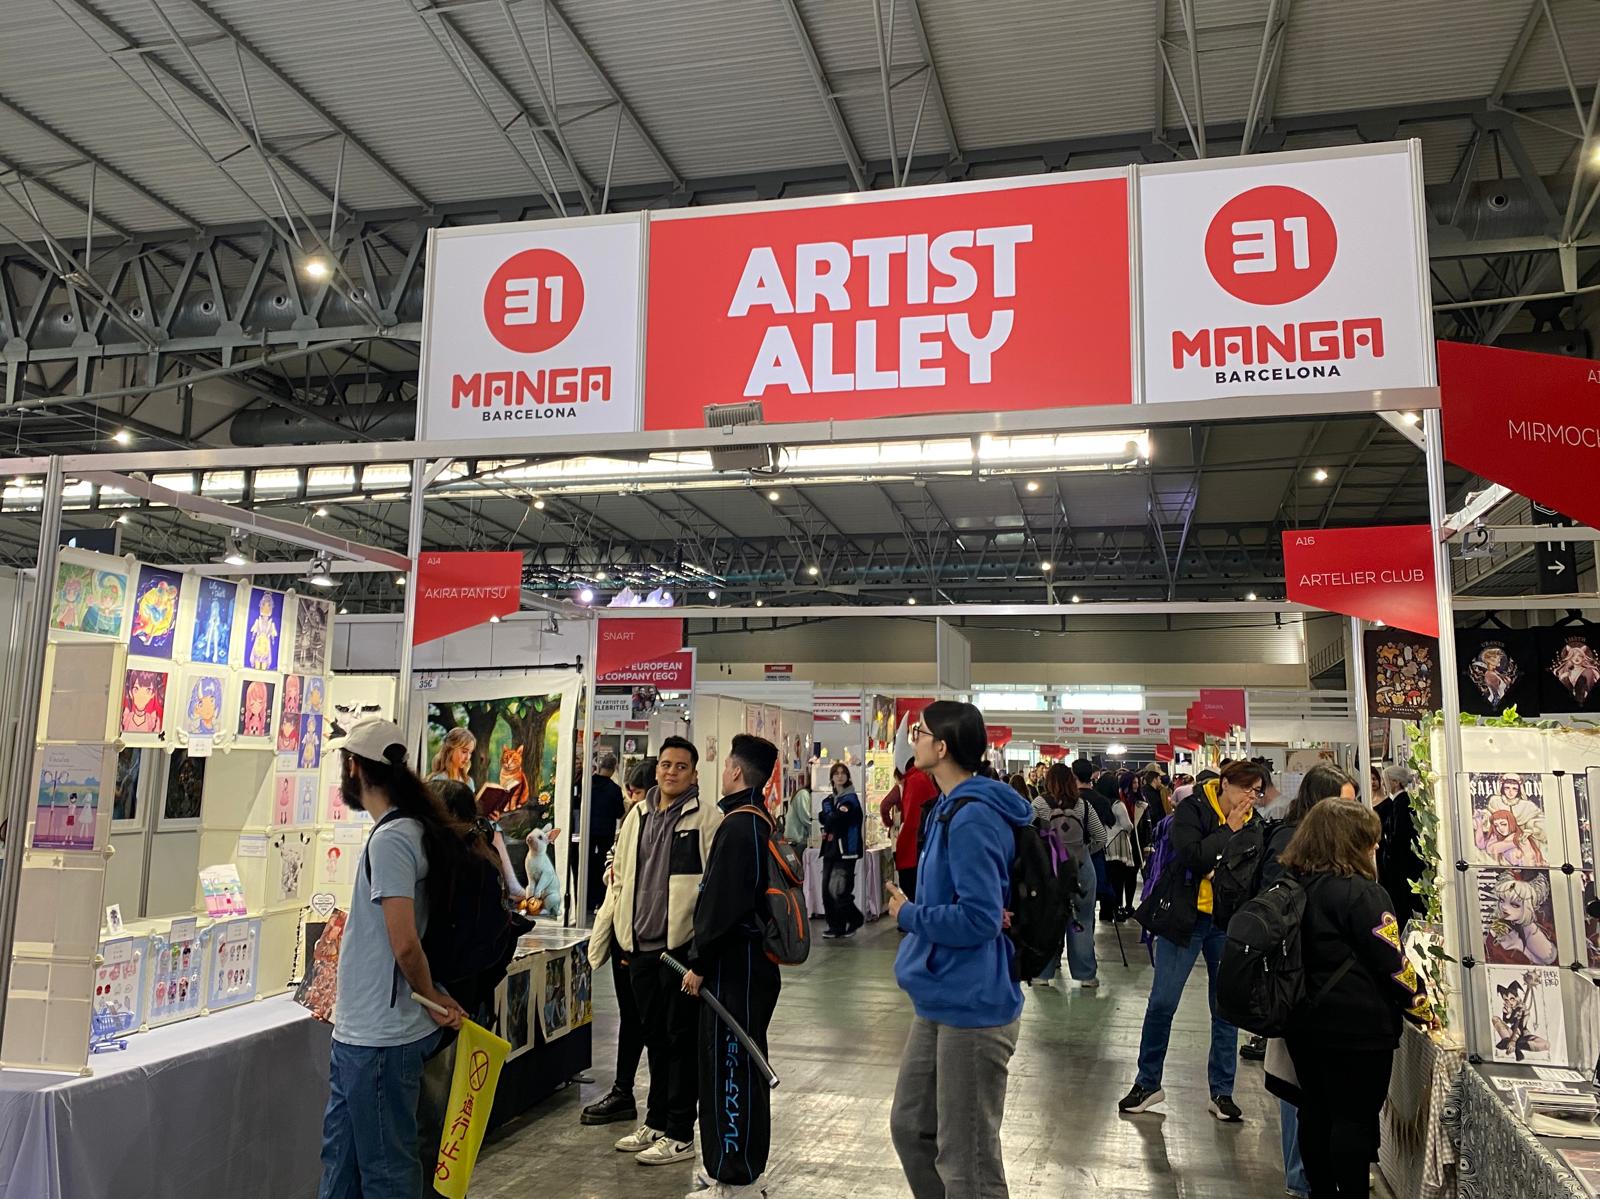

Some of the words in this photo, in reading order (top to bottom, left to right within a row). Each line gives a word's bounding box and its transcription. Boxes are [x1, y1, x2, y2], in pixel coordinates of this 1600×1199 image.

[1231, 216, 1310, 274] 31
[727, 224, 1033, 317] ARTIST
[503, 275, 564, 326] 31
[1171, 317, 1384, 369] MANGA
[743, 309, 1015, 397] ALLEY
[1215, 365, 1341, 384] BARCELONA
[451, 366, 612, 409] MANGA
[482, 407, 577, 422] BARCELONA
[1295, 536, 1316, 546] A16
[427, 557, 441, 565] A14
[1299, 571, 1376, 587] ARTELIER
[1380, 569, 1425, 583] CLUB
[424, 587, 458, 599] AKIRA
[460, 586, 507, 599] PANTSU
[603, 632, 635, 641] SNART
[631, 662, 683, 671] EUROPEAN
[605, 672, 651, 681] COMPANY
[652, 672, 678, 681] (EGC)
[1470, 780, 1543, 797] SALVON
